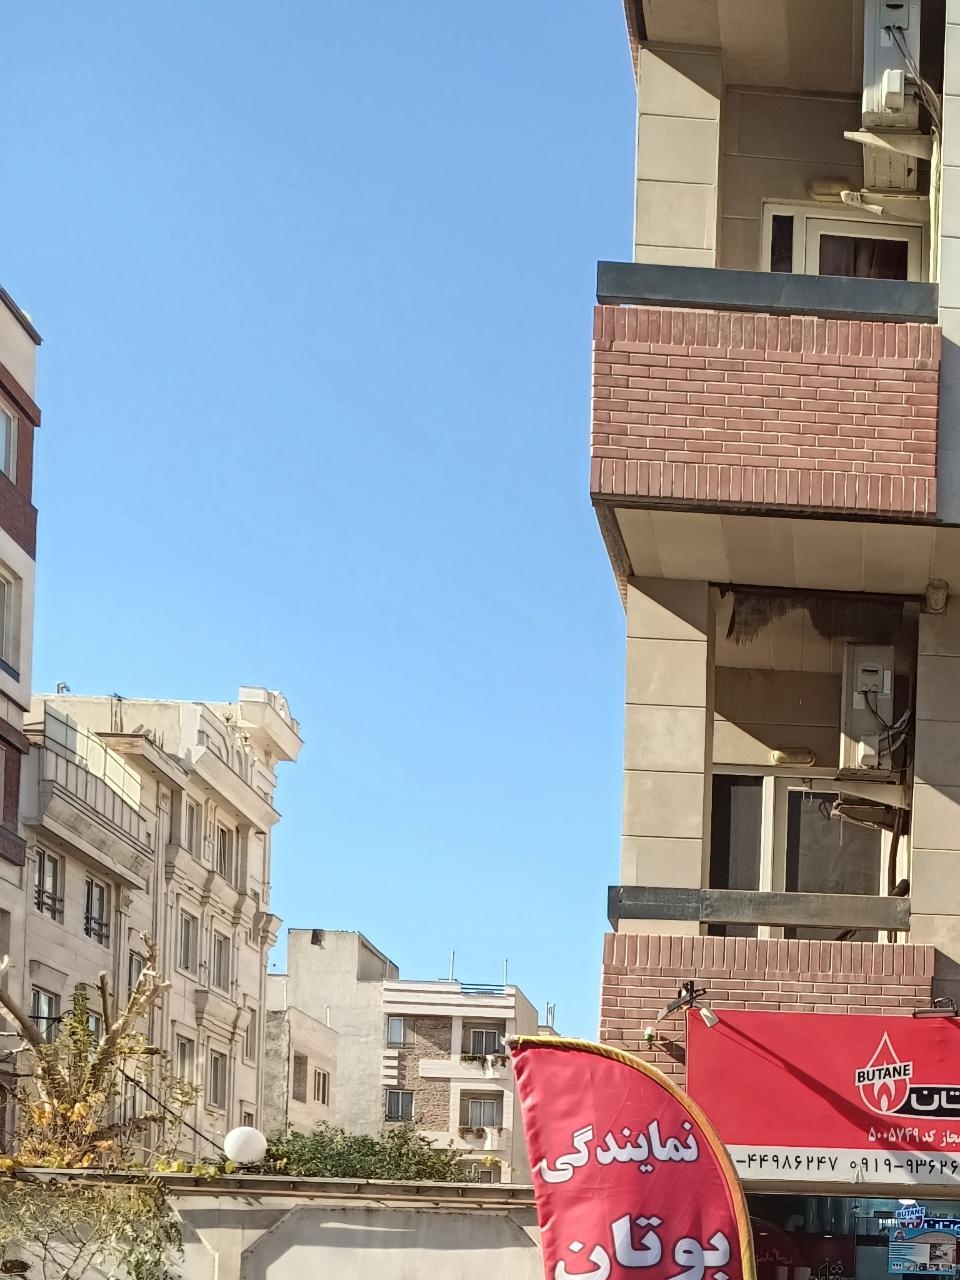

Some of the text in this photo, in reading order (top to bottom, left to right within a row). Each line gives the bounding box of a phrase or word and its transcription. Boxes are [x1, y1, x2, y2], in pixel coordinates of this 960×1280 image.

[857, 1063, 911, 1083] BUTANE
[868, 1126, 919, 1143] ۵۰۰۵۷۴۹
[921, 1128, 936, 1142] کد
[540, 1118, 699, 1185] نمایندگی
[736, 1153, 838, 1171] -۴۴۹۸۶۲۴۷
[896, 1206, 925, 1218] BUTANE
